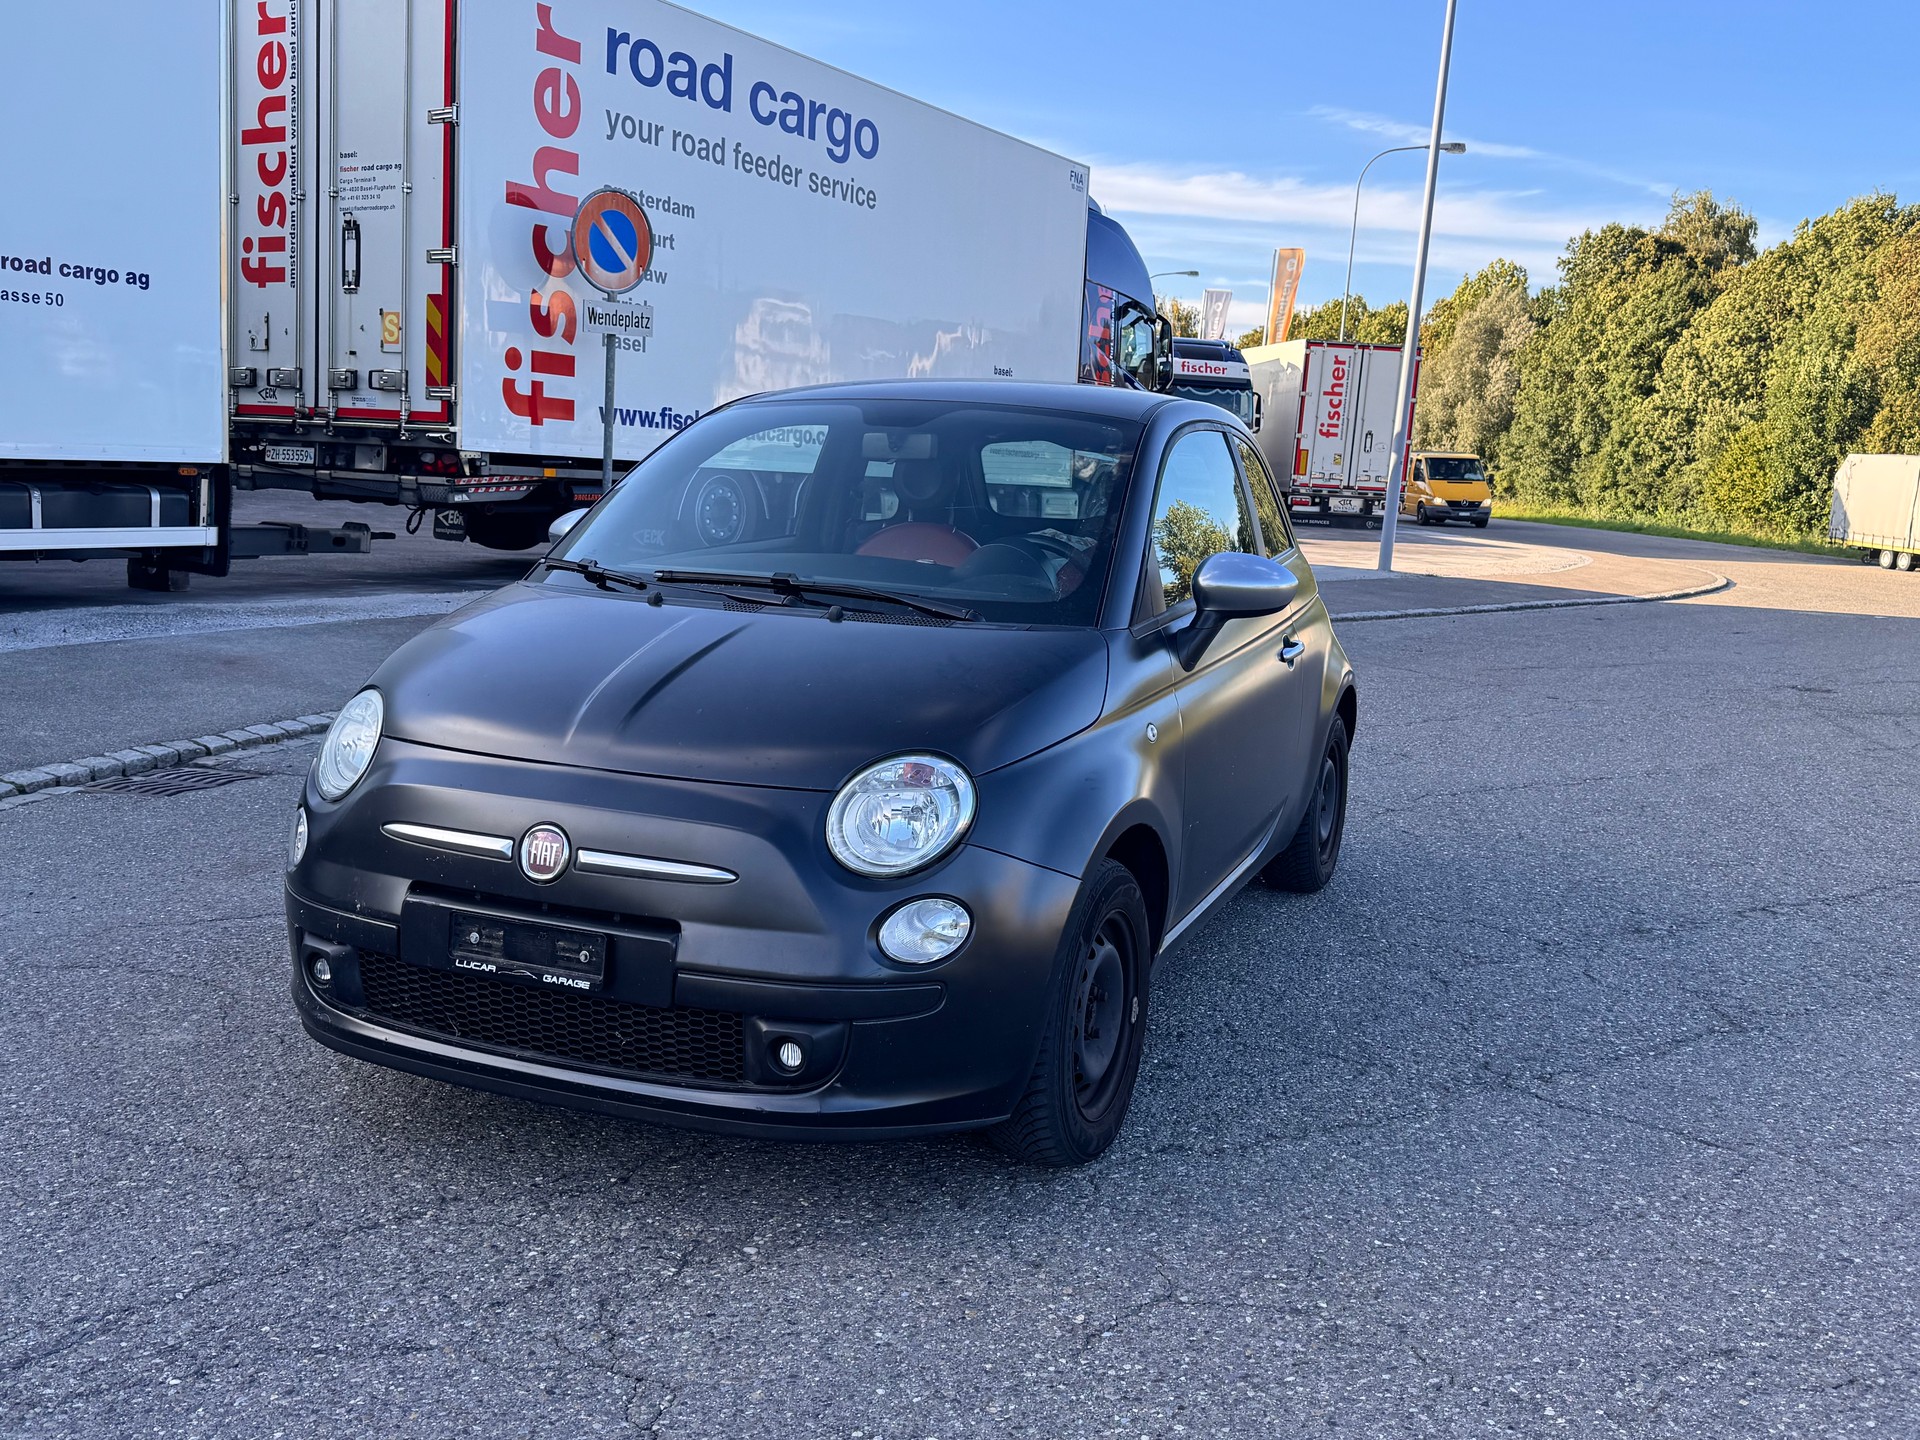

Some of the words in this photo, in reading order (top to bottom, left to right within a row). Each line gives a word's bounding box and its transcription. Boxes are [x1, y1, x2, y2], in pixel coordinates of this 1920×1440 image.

[605, 26, 733, 113] road
[748, 80, 880, 164] cargo
[241, 1, 287, 288] fischer
[340, 151, 358, 159] basel:
[361, 163, 375, 172] road
[375, 163, 393, 172] cargo
[394, 163, 402, 171] ag
[605, 108, 665, 147] your
[671, 128, 726, 166] road
[732, 142, 803, 188] feeder
[808, 170, 878, 210] service
[1070, 169, 1084, 186] FNA
[502, 2, 582, 426] fischer
[0, 255, 52, 275] road
[58, 263, 120, 286] cargo
[125, 271, 150, 290] ag
[0, 289, 41, 304] asse
[45, 292, 64, 307] 50
[587, 306, 651, 332] Wendeplatz
[993, 365, 1013, 378] basel:
[1180, 360, 1228, 375] fischer
[1318, 354, 1347, 439] fischer
[530, 840, 560, 867] FIAT
[455, 958, 497, 973] LUCAR
[542, 973, 591, 990] GARAGE
